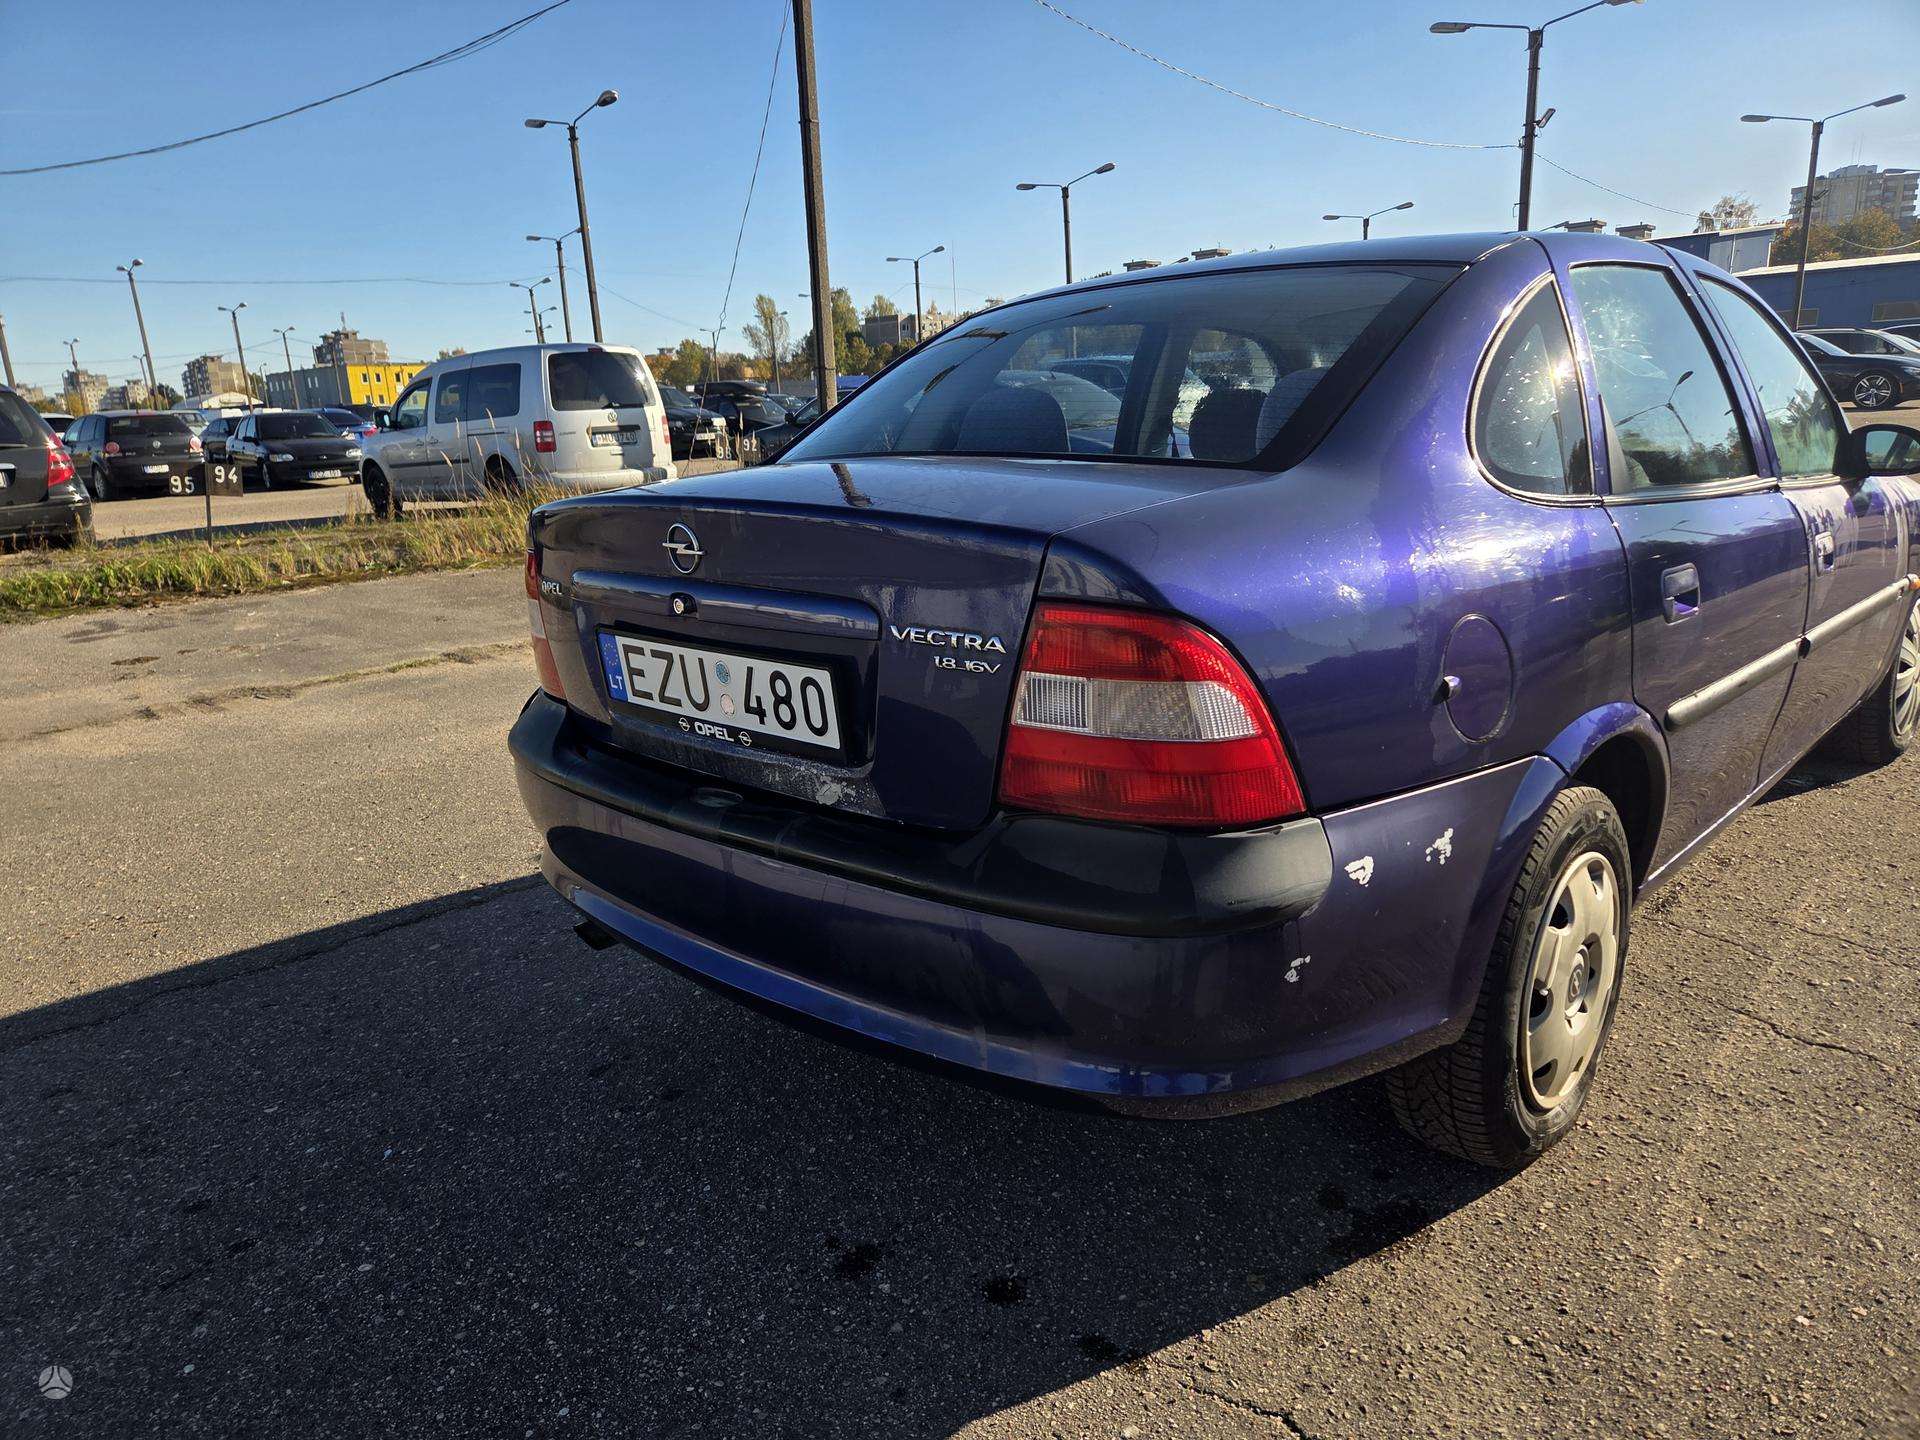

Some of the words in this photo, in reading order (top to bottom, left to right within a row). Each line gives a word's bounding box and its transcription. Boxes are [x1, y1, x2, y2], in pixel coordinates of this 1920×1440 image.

[214, 465, 238, 484] 94
[170, 475, 195, 494] 95
[541, 580, 563, 595] OPEL
[889, 625, 1007, 654] VECTRA
[609, 674, 623, 690] LT
[622, 643, 710, 712] EZU
[743, 666, 829, 737] 480
[694, 721, 735, 742] OPEL
